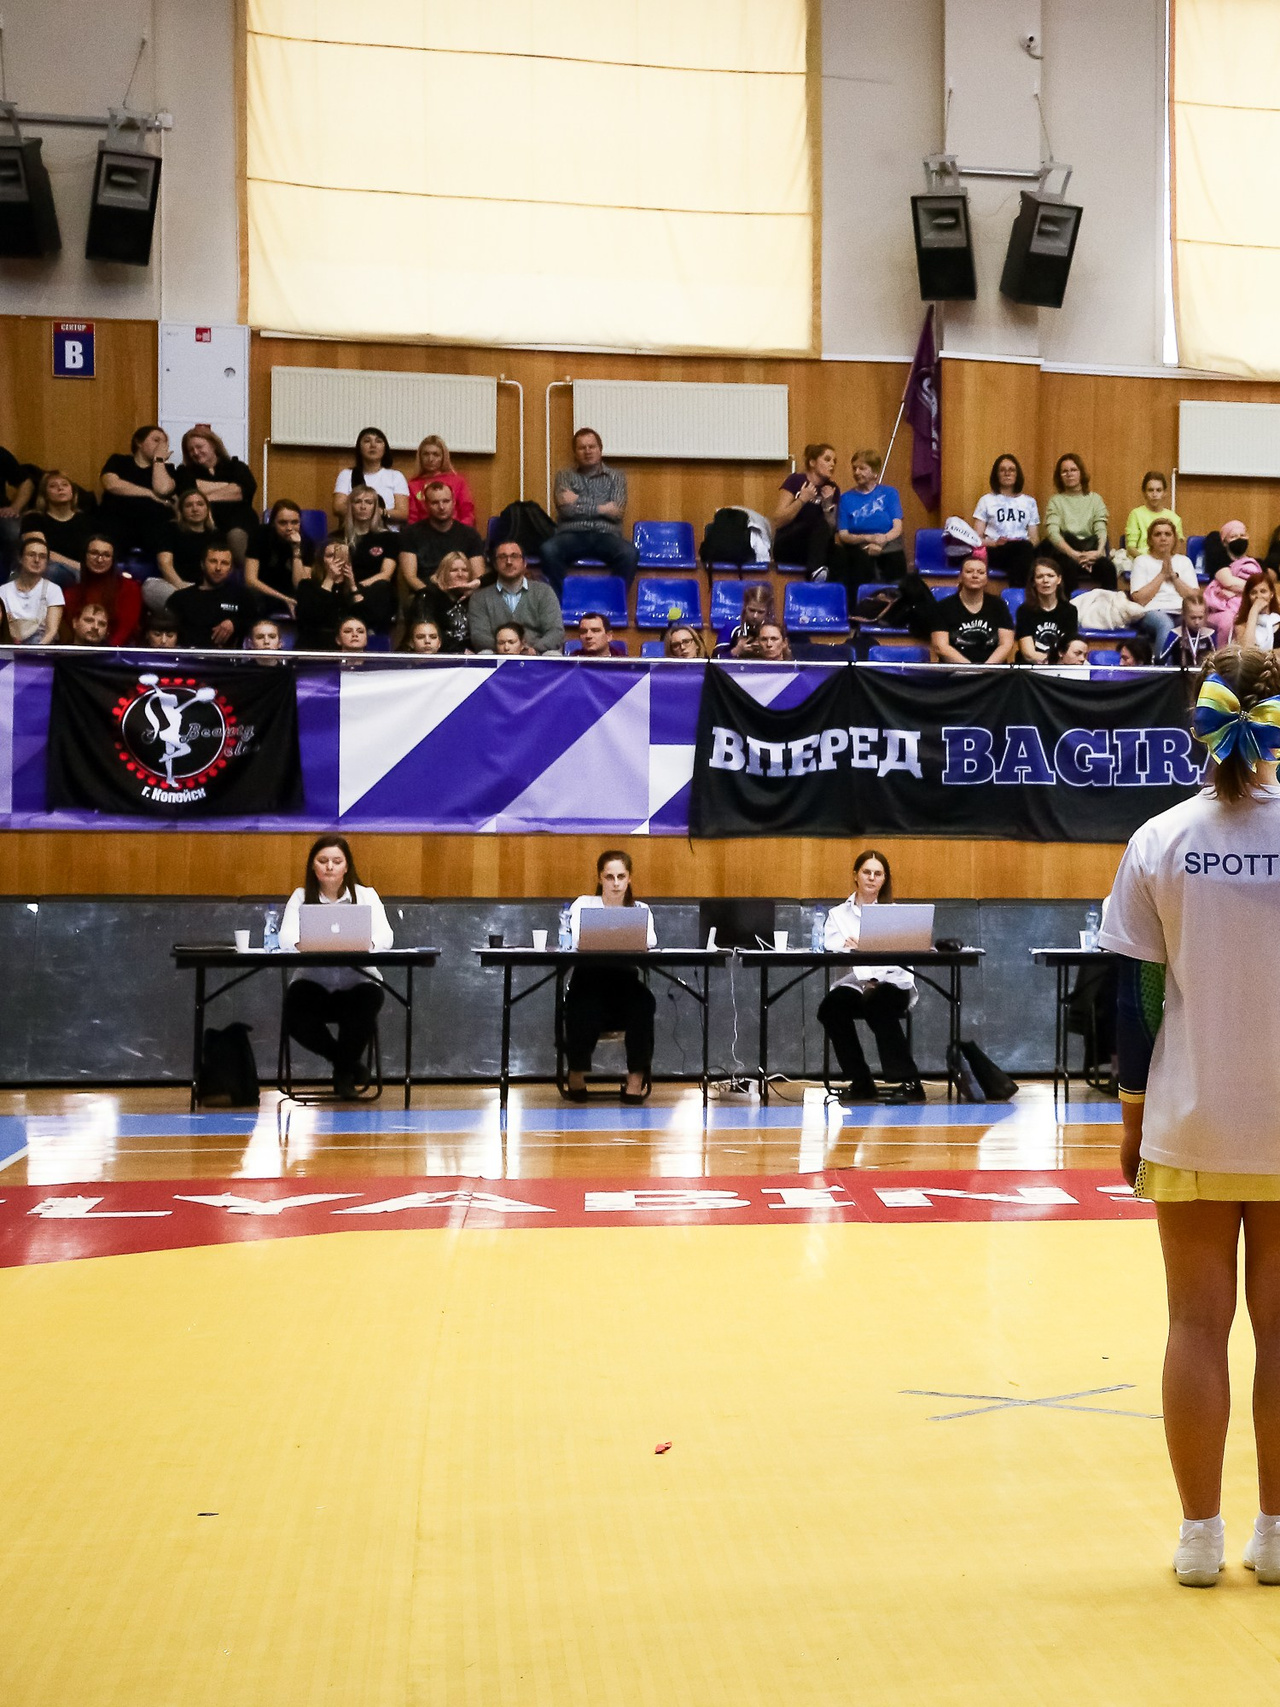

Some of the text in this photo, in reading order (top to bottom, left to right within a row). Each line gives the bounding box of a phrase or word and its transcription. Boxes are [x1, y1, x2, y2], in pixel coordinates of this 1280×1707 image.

[996, 508, 1026, 523] GAP
[708, 726, 923, 779] ВПЕРЕД
[941, 725, 1208, 787] BAGIR
